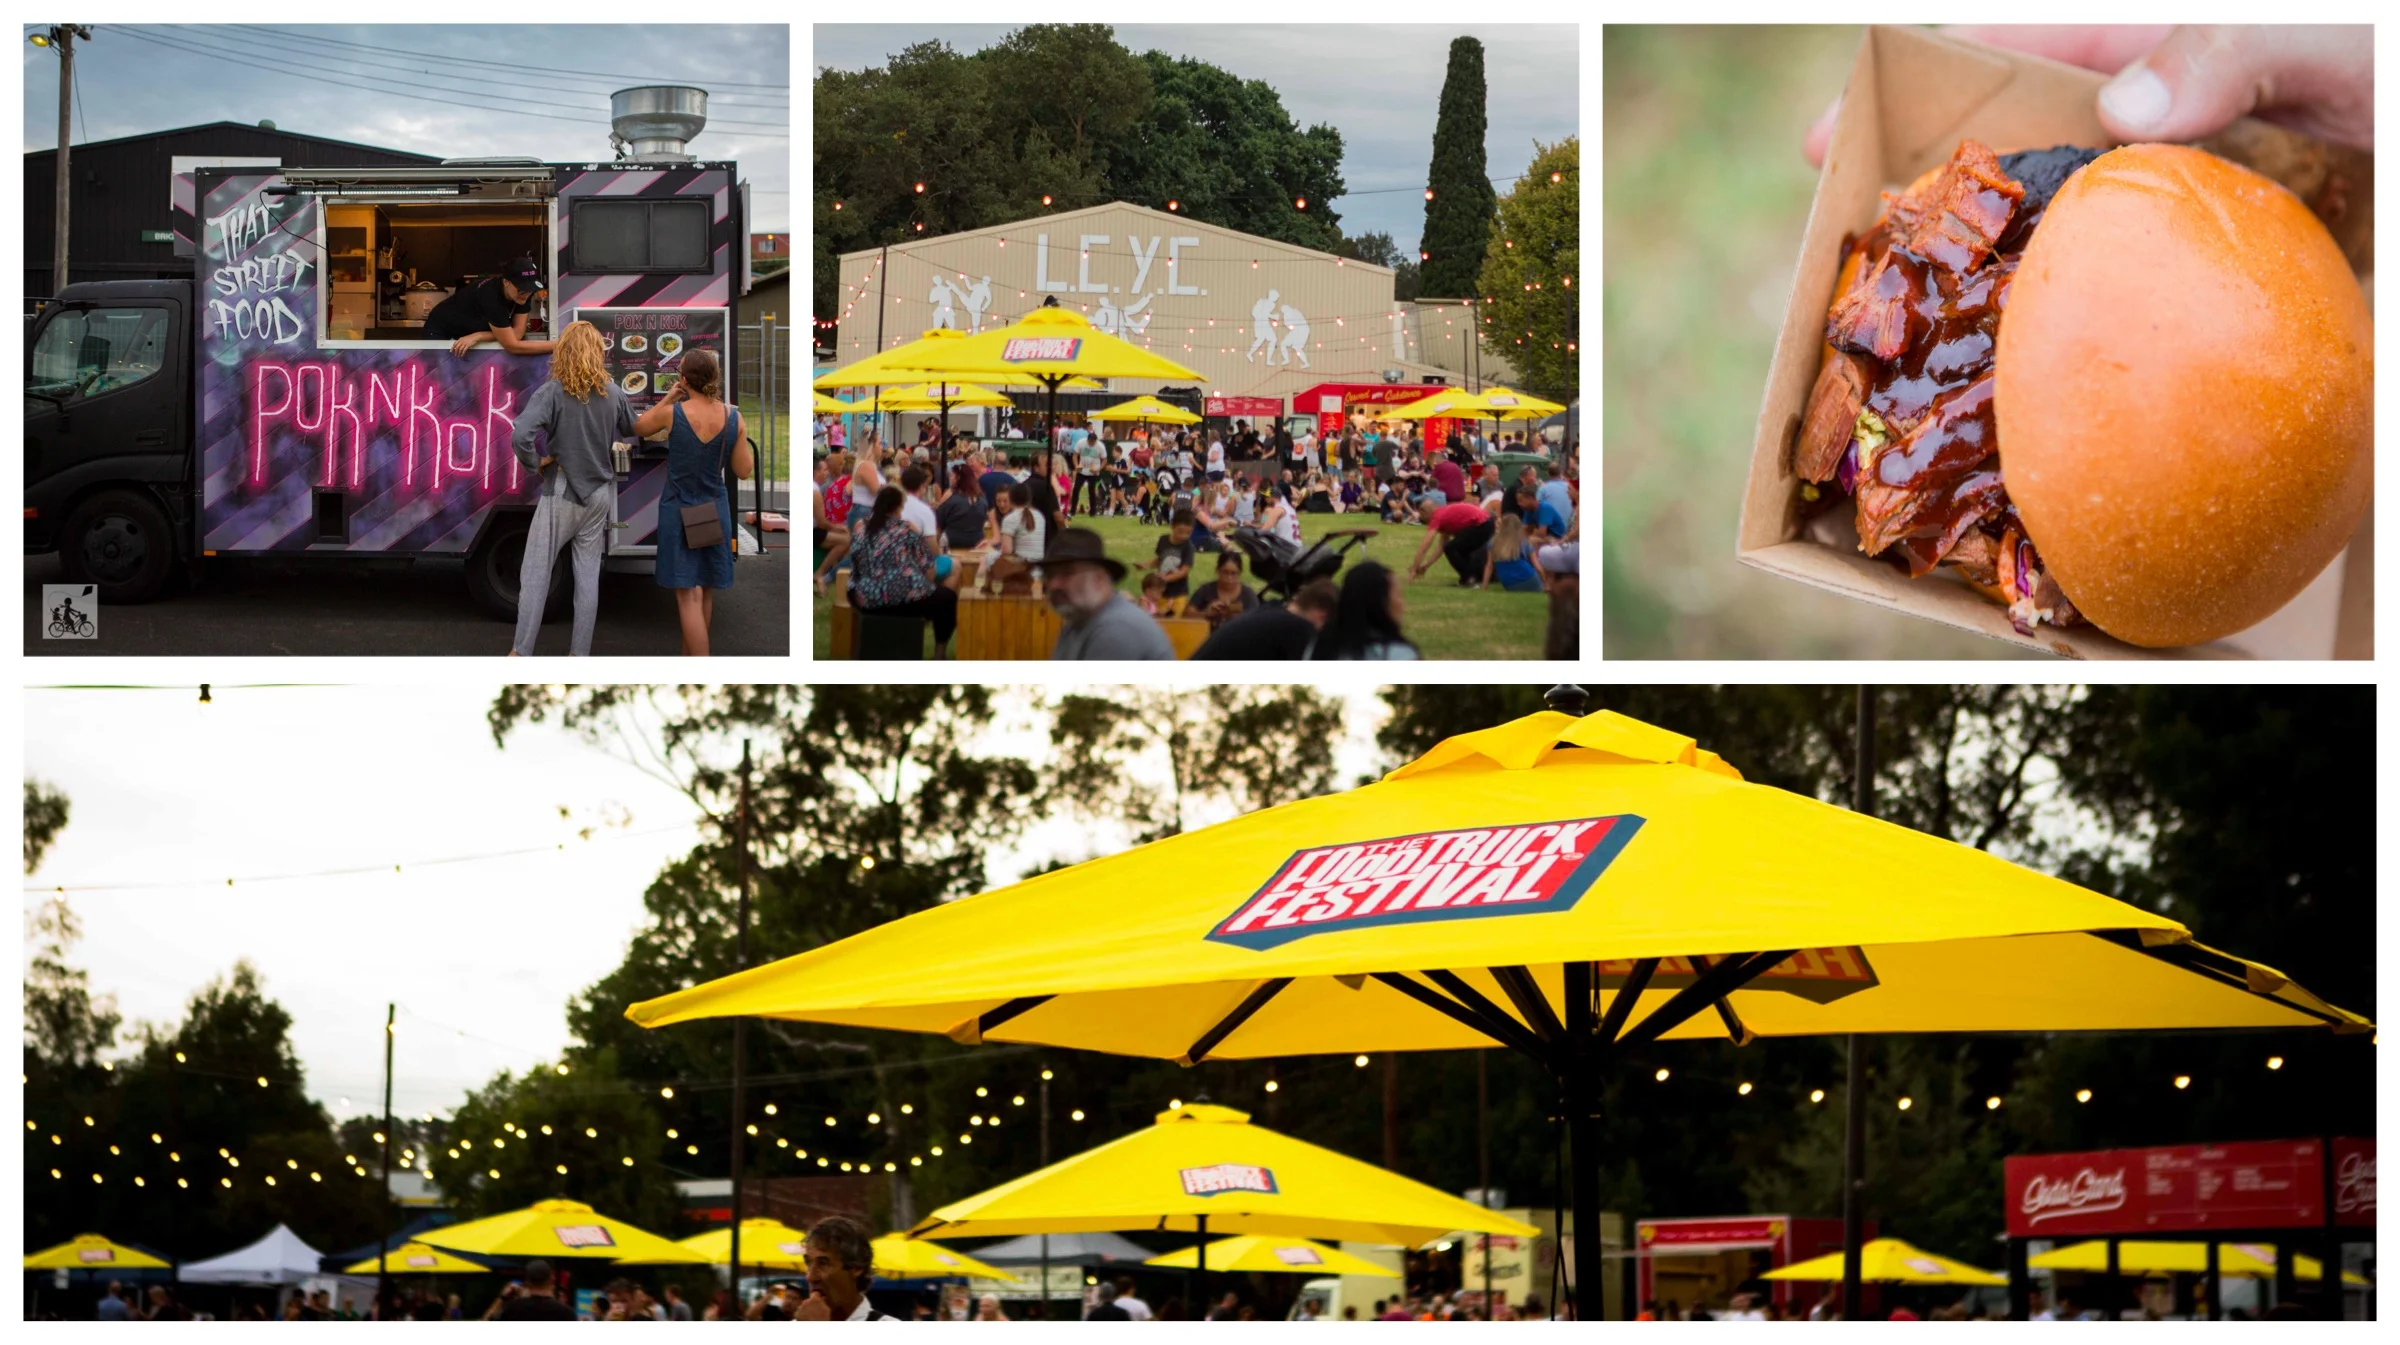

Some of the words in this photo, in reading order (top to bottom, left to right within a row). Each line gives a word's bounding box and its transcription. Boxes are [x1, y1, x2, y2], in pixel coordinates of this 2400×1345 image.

[206, 202, 284, 263] THAT
[213, 249, 314, 296] STREET
[209, 296, 302, 345] FOOD
[614, 314, 642, 330] POK
[646, 314, 657, 330] N
[660, 314, 687, 330] KOK
[1274, 845, 1419, 893] FOOD
[1414, 820, 1600, 872] TRUCK
[1366, 837, 1427, 855] THE
[1226, 855, 1559, 932] FESTIVAL
